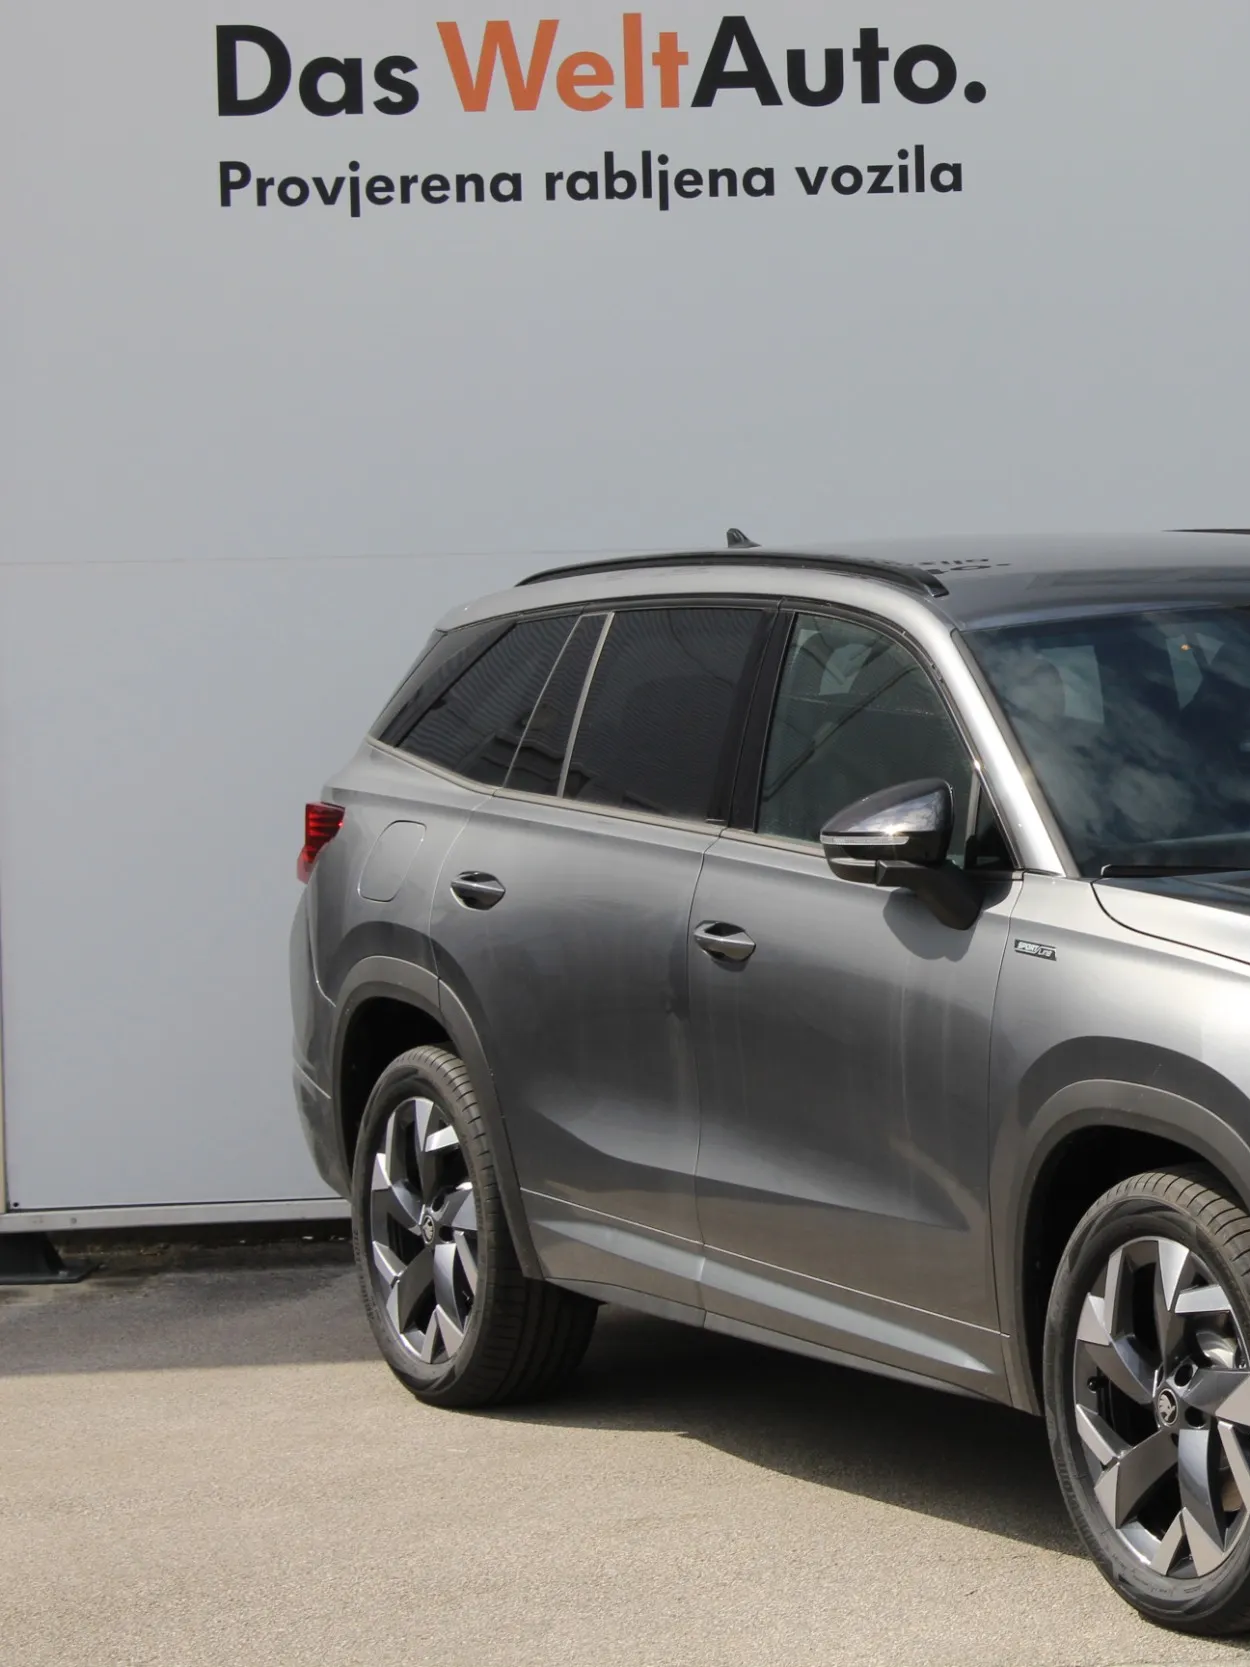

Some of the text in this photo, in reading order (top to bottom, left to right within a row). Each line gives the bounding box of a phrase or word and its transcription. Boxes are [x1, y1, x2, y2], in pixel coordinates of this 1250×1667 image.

[216, 13, 987, 117] Das WeltAuto.
[219, 145, 963, 217] Provjerena rabljena vozila
